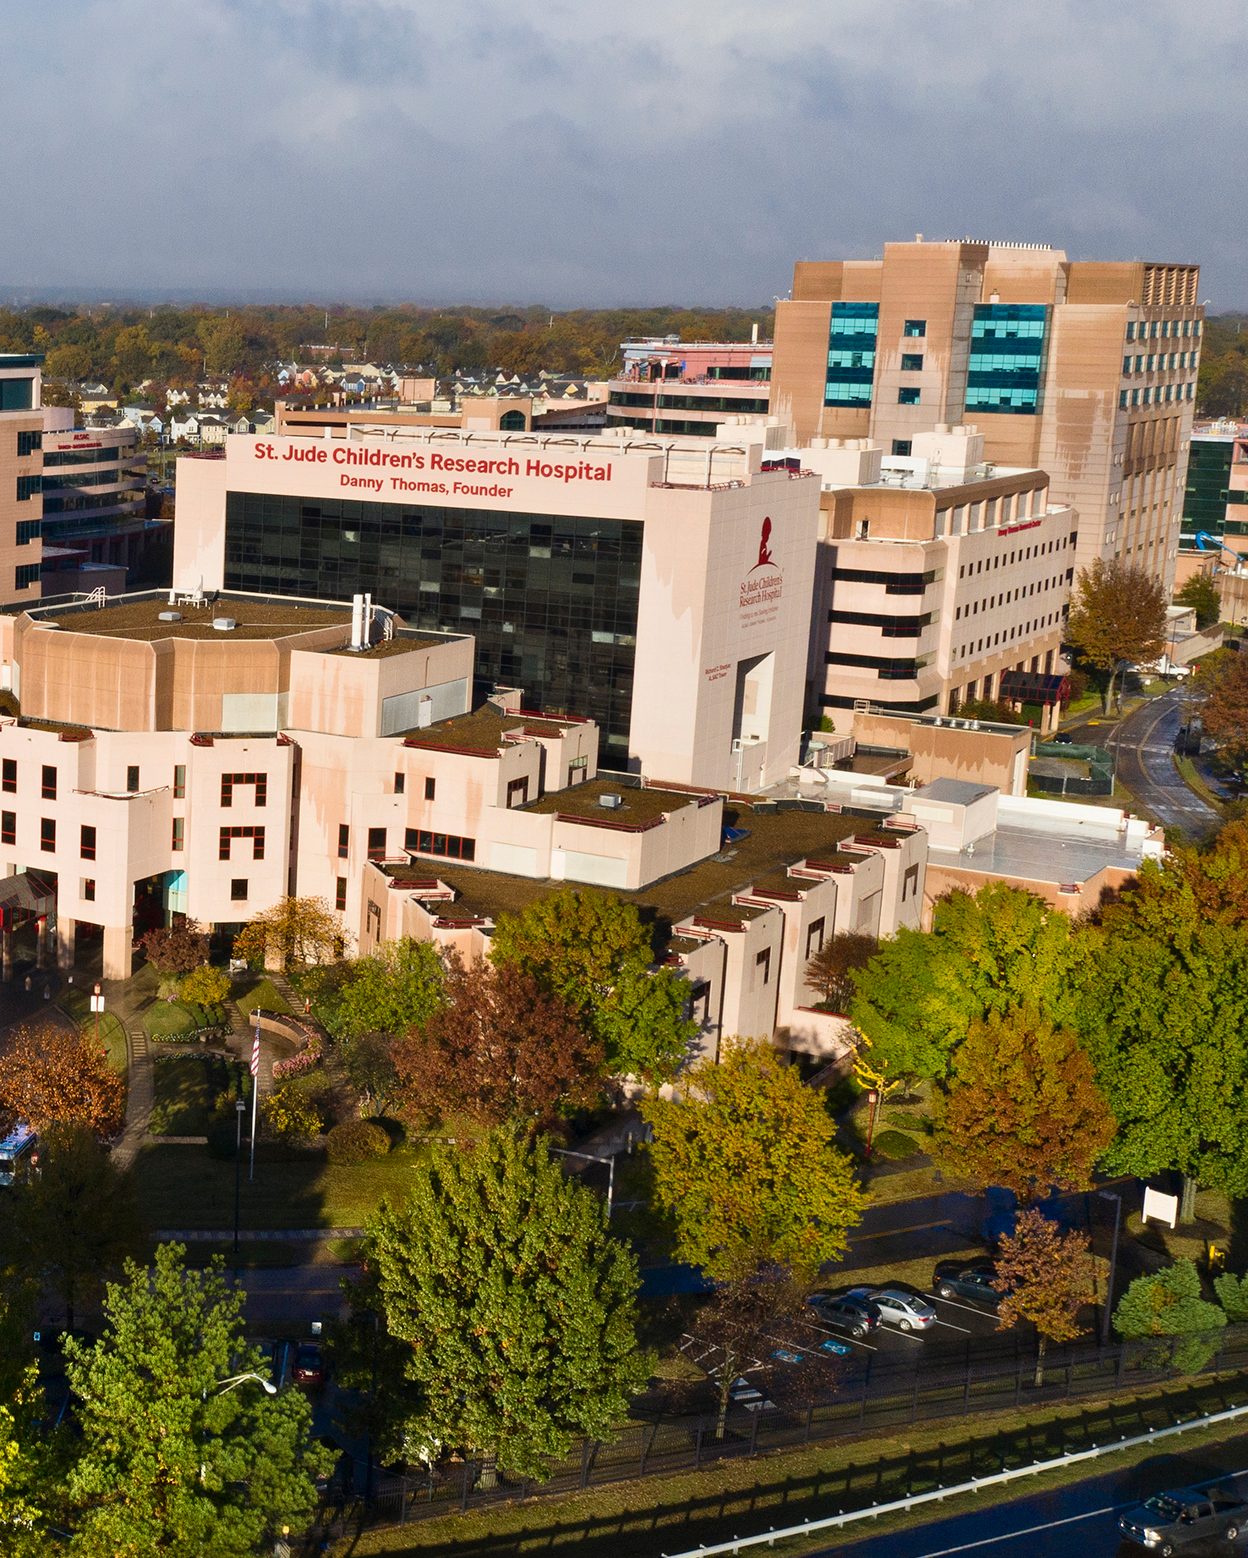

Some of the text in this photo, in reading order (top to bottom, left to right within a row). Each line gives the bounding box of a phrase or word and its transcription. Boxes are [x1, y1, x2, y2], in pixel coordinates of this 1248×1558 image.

[254, 443, 612, 483] St. Jude Children's Research Hospital
[340, 474, 513, 498] Danny Thomas, Founder
